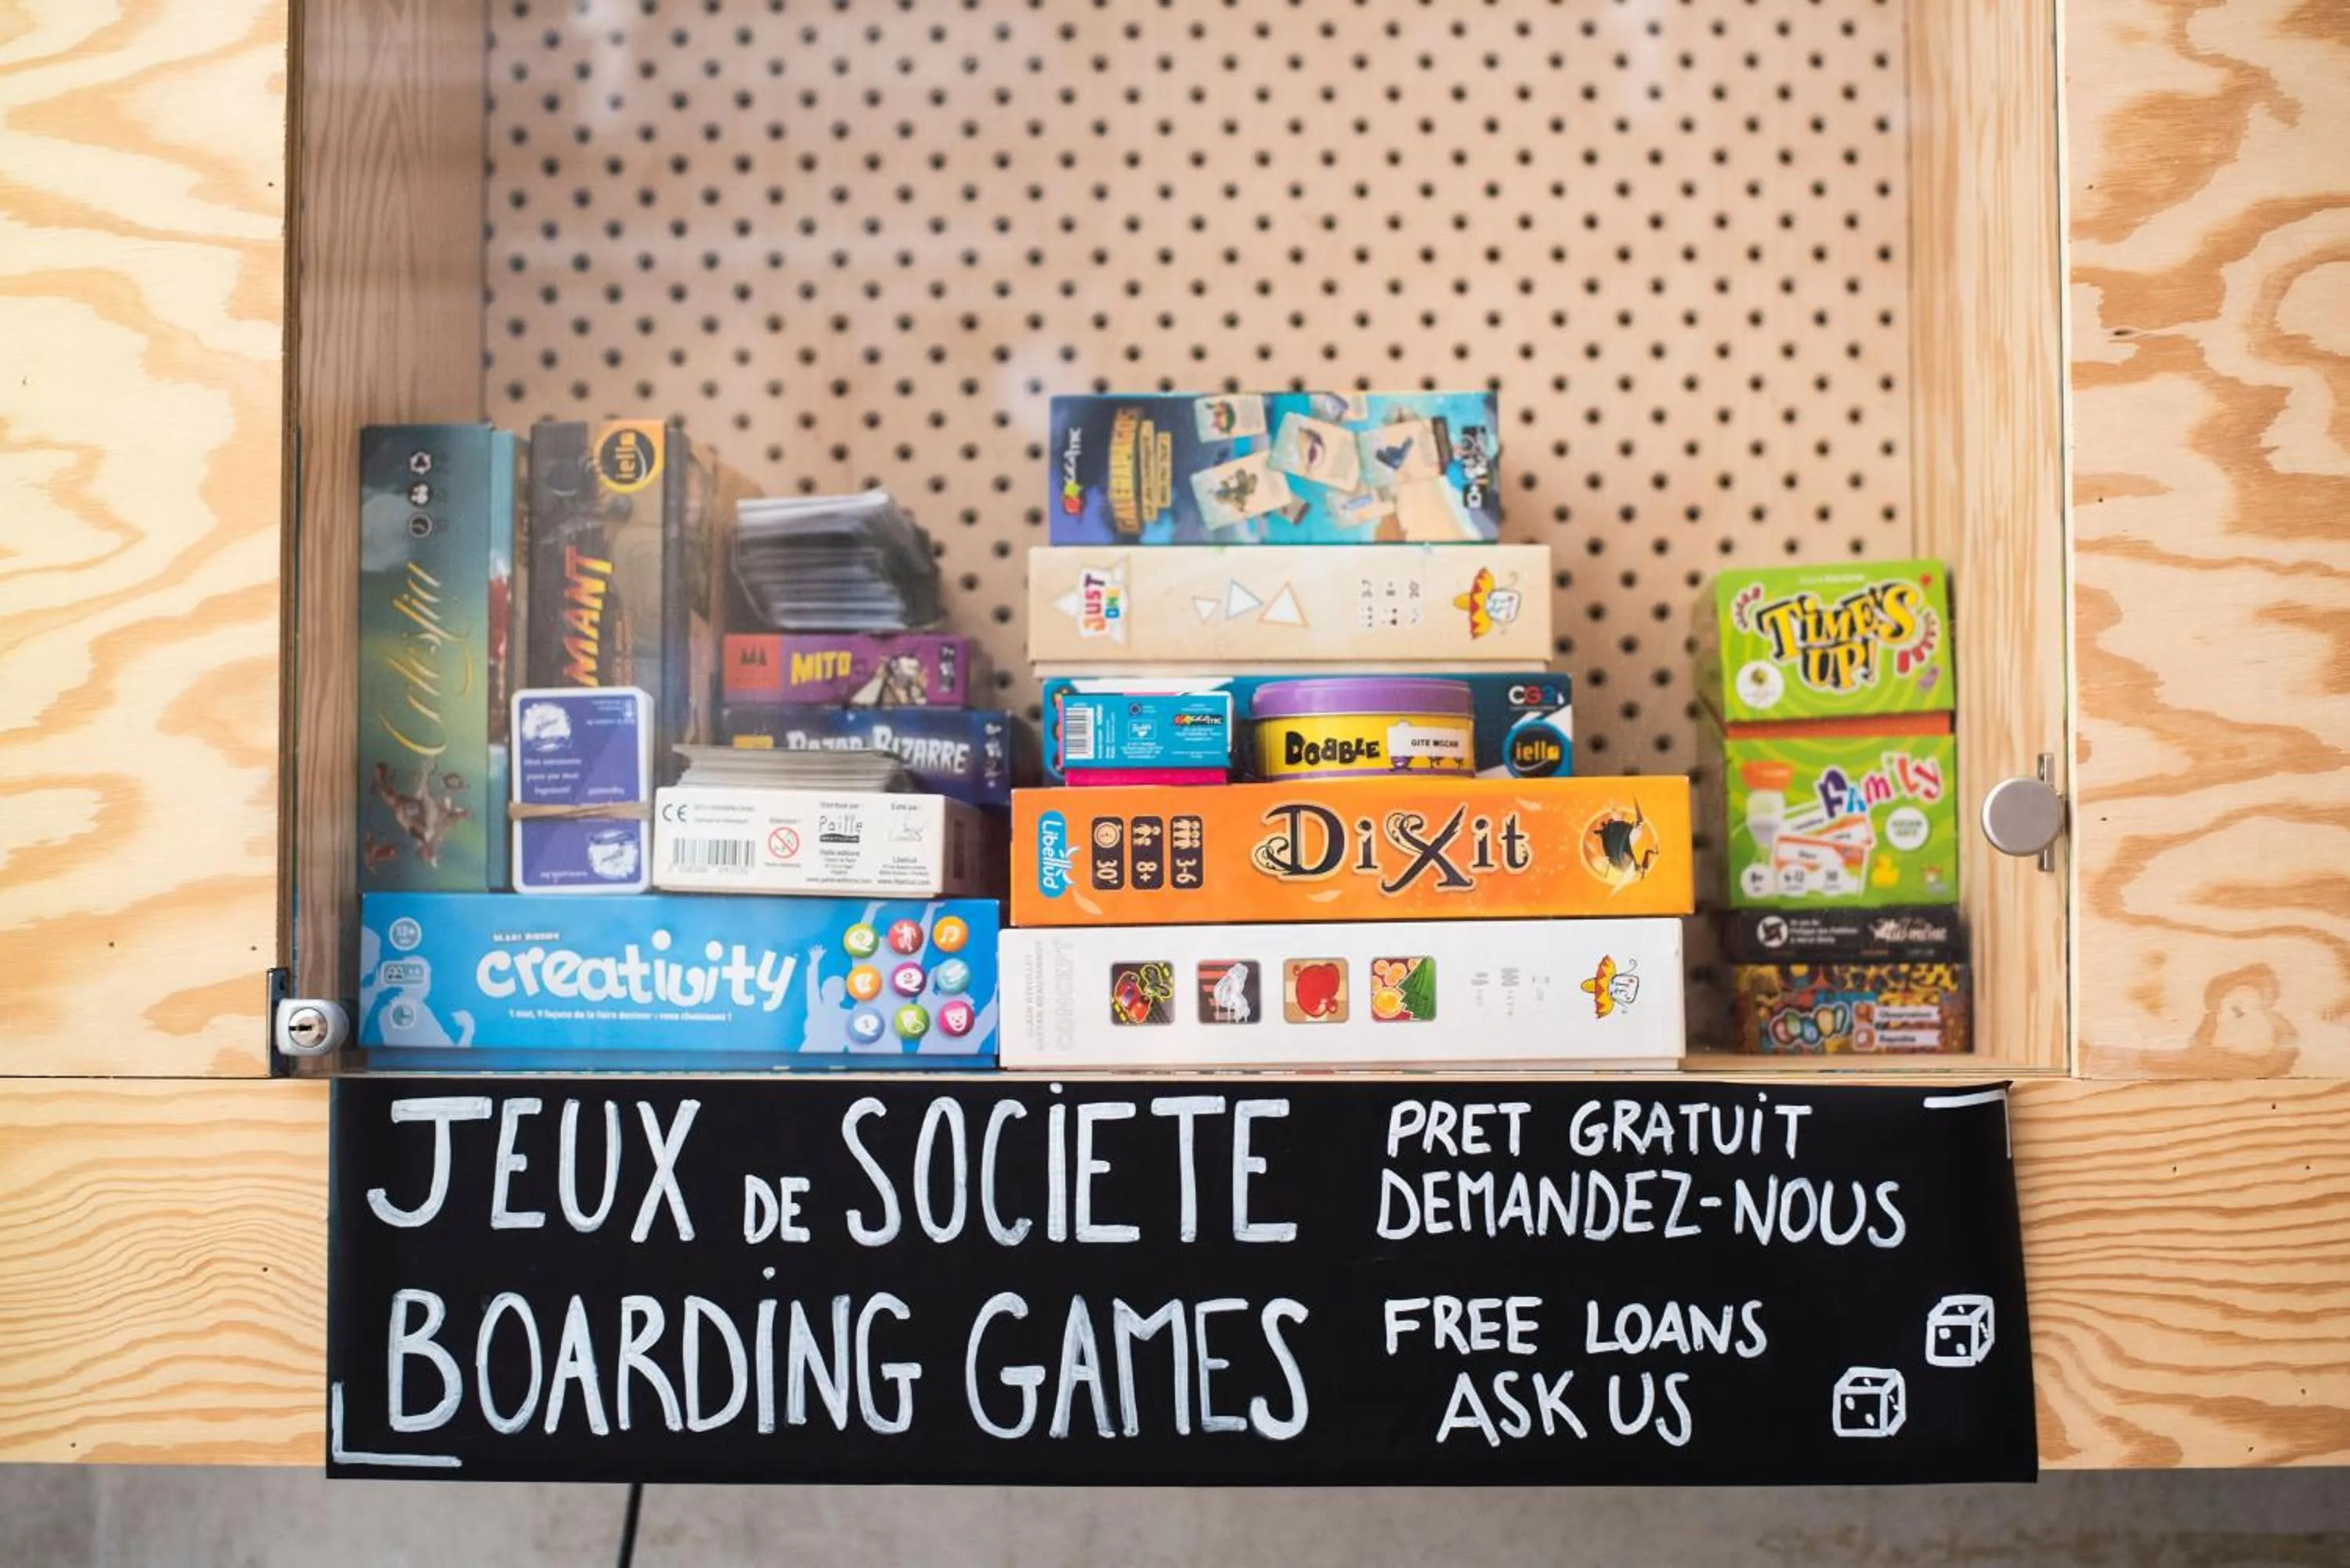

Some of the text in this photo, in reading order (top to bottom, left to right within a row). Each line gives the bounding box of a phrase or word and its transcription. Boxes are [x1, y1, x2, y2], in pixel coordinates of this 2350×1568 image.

[563, 544, 614, 687] MANT
[1083, 573, 1105, 631] JUST
[790, 651, 852, 686] MITO
[1516, 739, 1560, 761] iello
[1042, 819, 1073, 890] Libellud
[1136, 861, 1158, 882] 8+
[1176, 858, 1197, 884] 3-6
[476, 930, 797, 1011] creativity
[1388, 1100, 1531, 1157] PRET
[367, 1097, 700, 1242] JEUX
[744, 1175, 810, 1244] DE
[1377, 1169, 1905, 1248] DEMANDEZ-NOUS
[1385, 1295, 1766, 1357] FREE LOANS
[966, 1292, 1308, 1440] GAMES
[1437, 1371, 1691, 1447] ASK US
